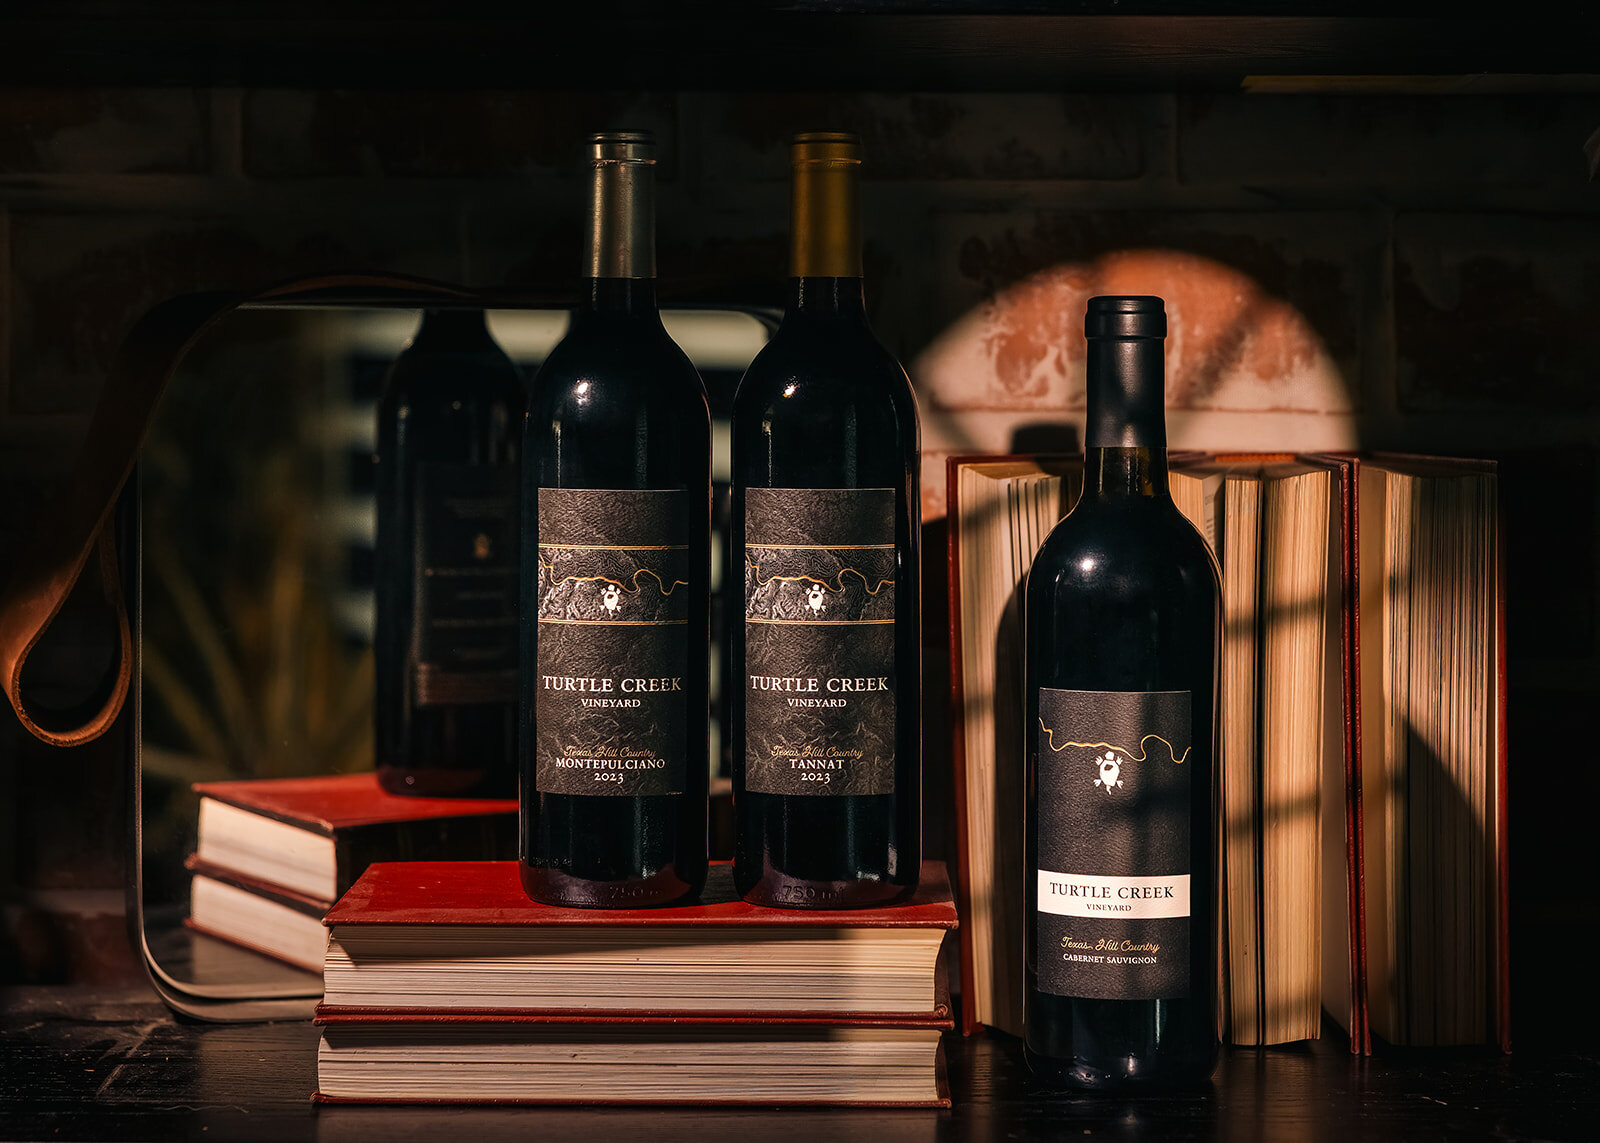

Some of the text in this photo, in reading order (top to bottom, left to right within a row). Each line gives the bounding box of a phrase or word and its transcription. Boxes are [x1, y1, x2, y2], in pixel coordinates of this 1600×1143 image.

[543, 675, 681, 693] TURTLE CREEK
[750, 675, 888, 692] TURTLE CREEK
[581, 698, 641, 708] VINEYARD
[787, 698, 847, 708] VINEYARD
[563, 745, 656, 759] Texas Hill Country
[771, 745, 863, 759] Texas Hill Country
[556, 757, 665, 769] MONTEPULCIANO
[789, 758, 844, 769] TANNAT
[594, 773, 624, 784] 2023
[801, 773, 831, 784] 2023
[782, 885, 817, 899] 750
[1050, 882, 1174, 899] TURTLE CREEK
[1086, 903, 1132, 912] VINEYARD
[1060, 936, 1160, 954] Texas Hill Country
[1063, 953, 1157, 964] CABERNET SAUVIGNON
